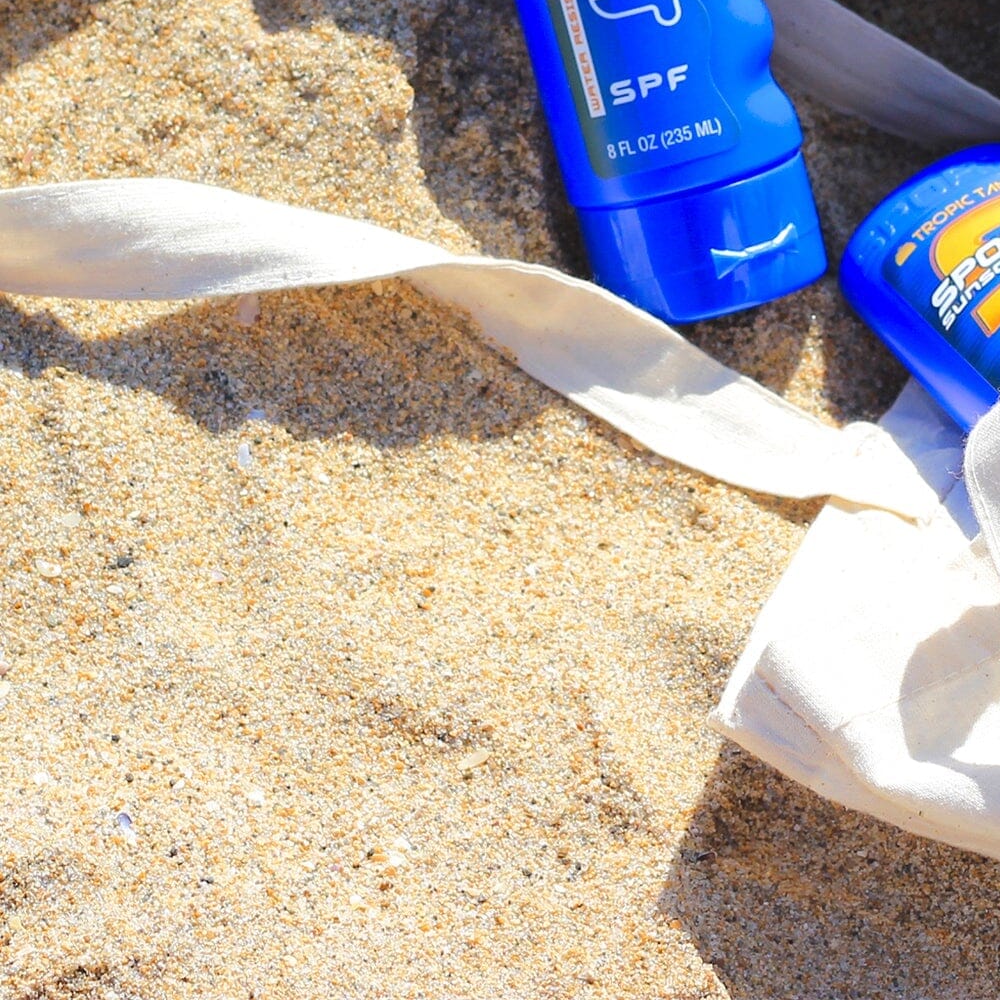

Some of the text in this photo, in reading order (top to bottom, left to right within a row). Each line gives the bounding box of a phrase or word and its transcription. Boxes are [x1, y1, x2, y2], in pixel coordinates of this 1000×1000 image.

[578, 52, 600, 111] WATER
[609, 63, 688, 106] SPF
[607, 117, 722, 159] 8 FL OZ (235 ML)
[912, 194, 975, 241] TROPIC
